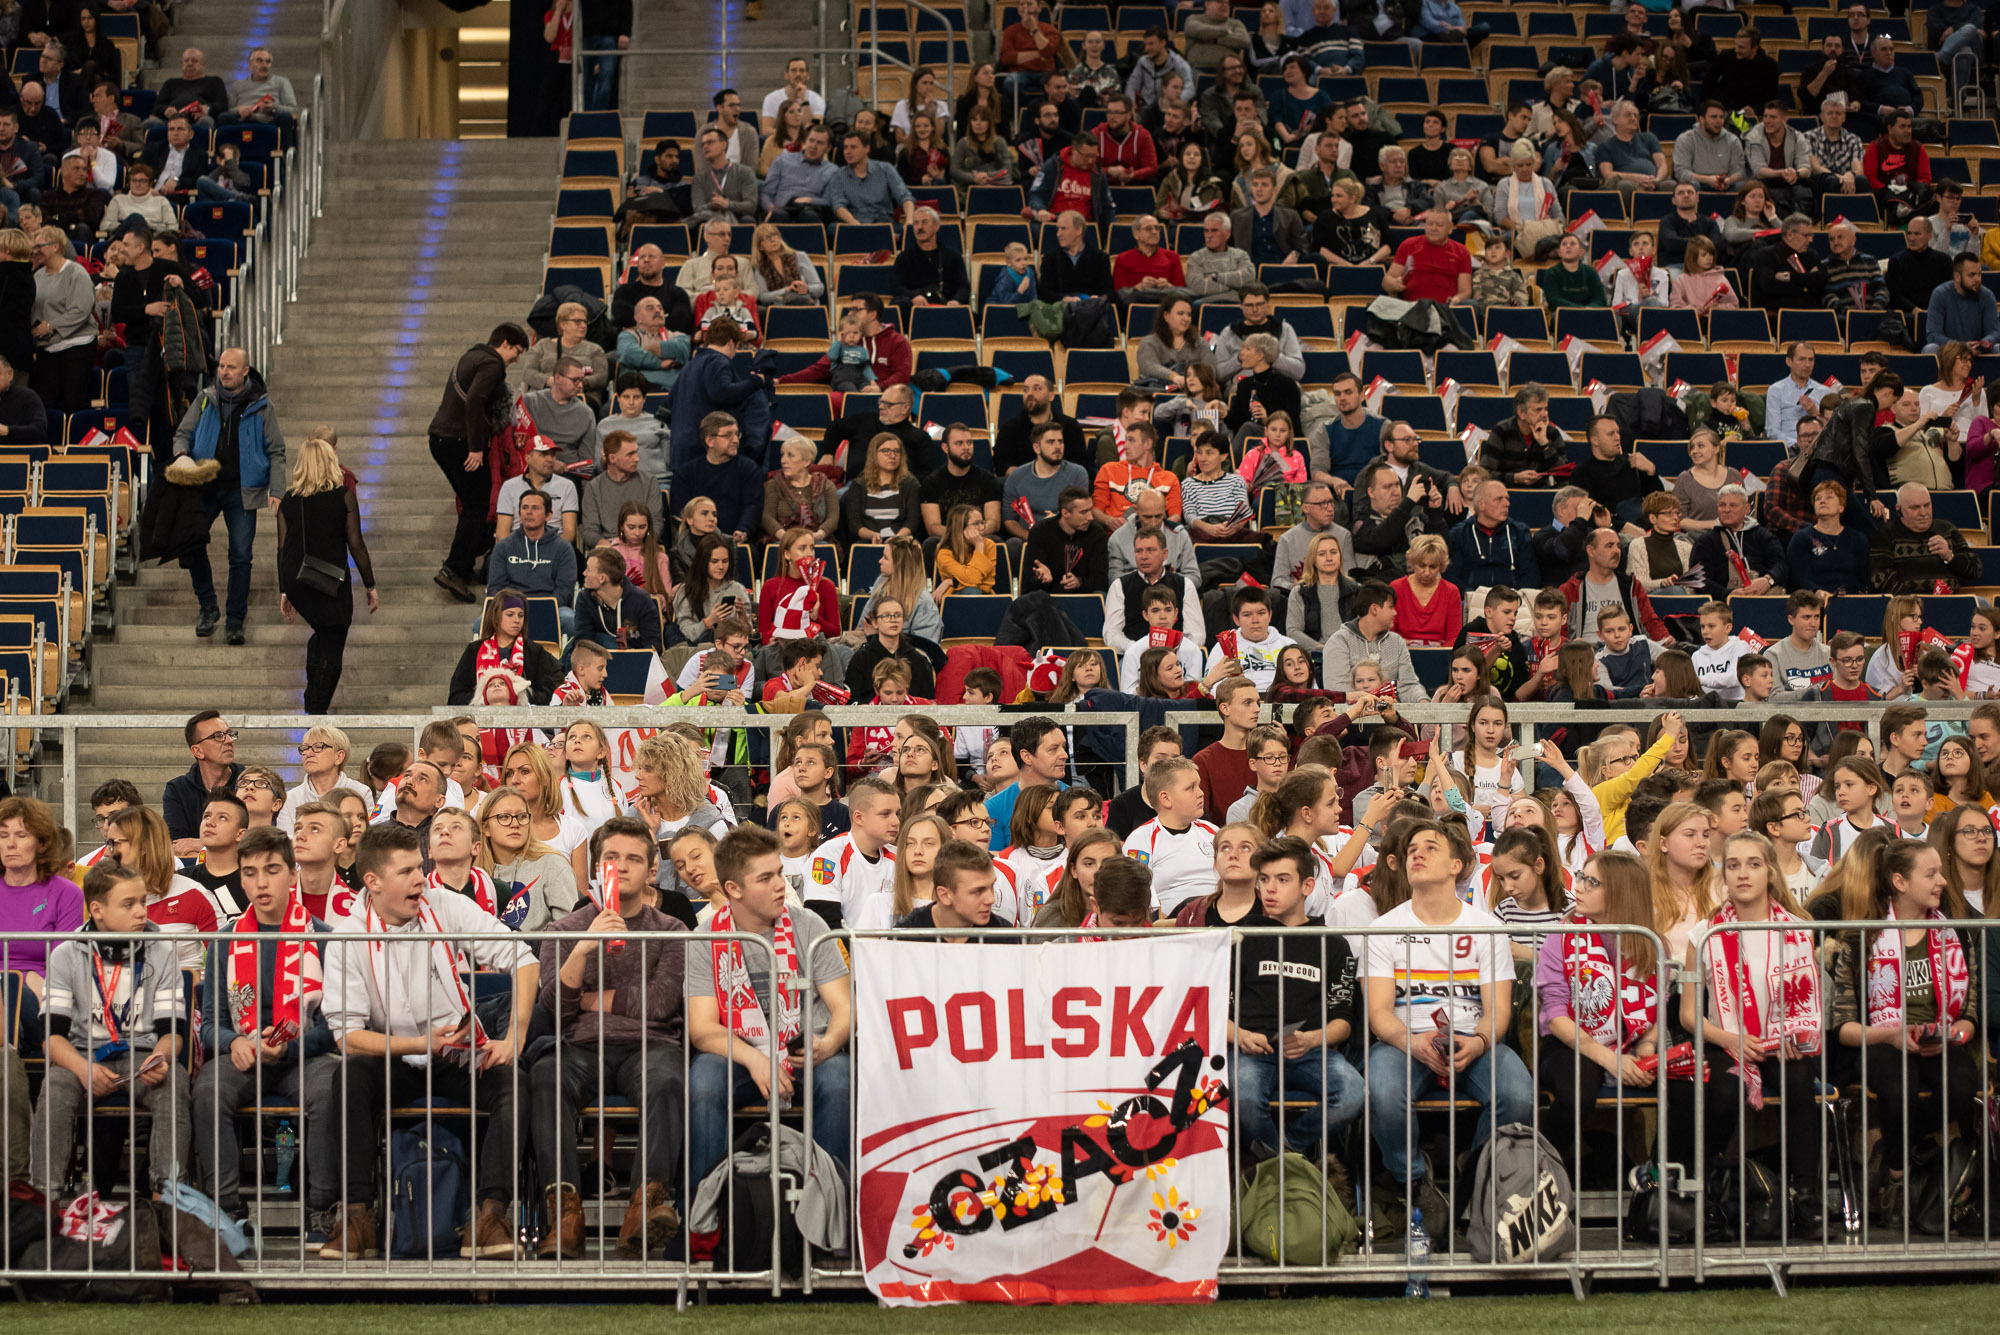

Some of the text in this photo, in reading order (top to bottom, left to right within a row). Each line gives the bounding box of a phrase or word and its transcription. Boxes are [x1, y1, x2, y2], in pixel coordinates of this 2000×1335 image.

[1886, 154, 1906, 164] NIKE
[508, 556, 551, 570] Champion
[1787, 665, 1830, 677] TOMMY
[1455, 935, 1472, 959] 9
[1262, 963, 1317, 979] BEYND COOL
[1566, 962, 1611, 972] BAŁO
[1714, 959, 1731, 1014] ZAWSZE
[1734, 962, 1753, 1009] BIAO
[113, 1003, 141, 1011] RIGT
[92, 1013, 140, 1027] NW
[886, 986, 1209, 1071] POLSKA
[1508, 1180, 1563, 1258] NIKE
